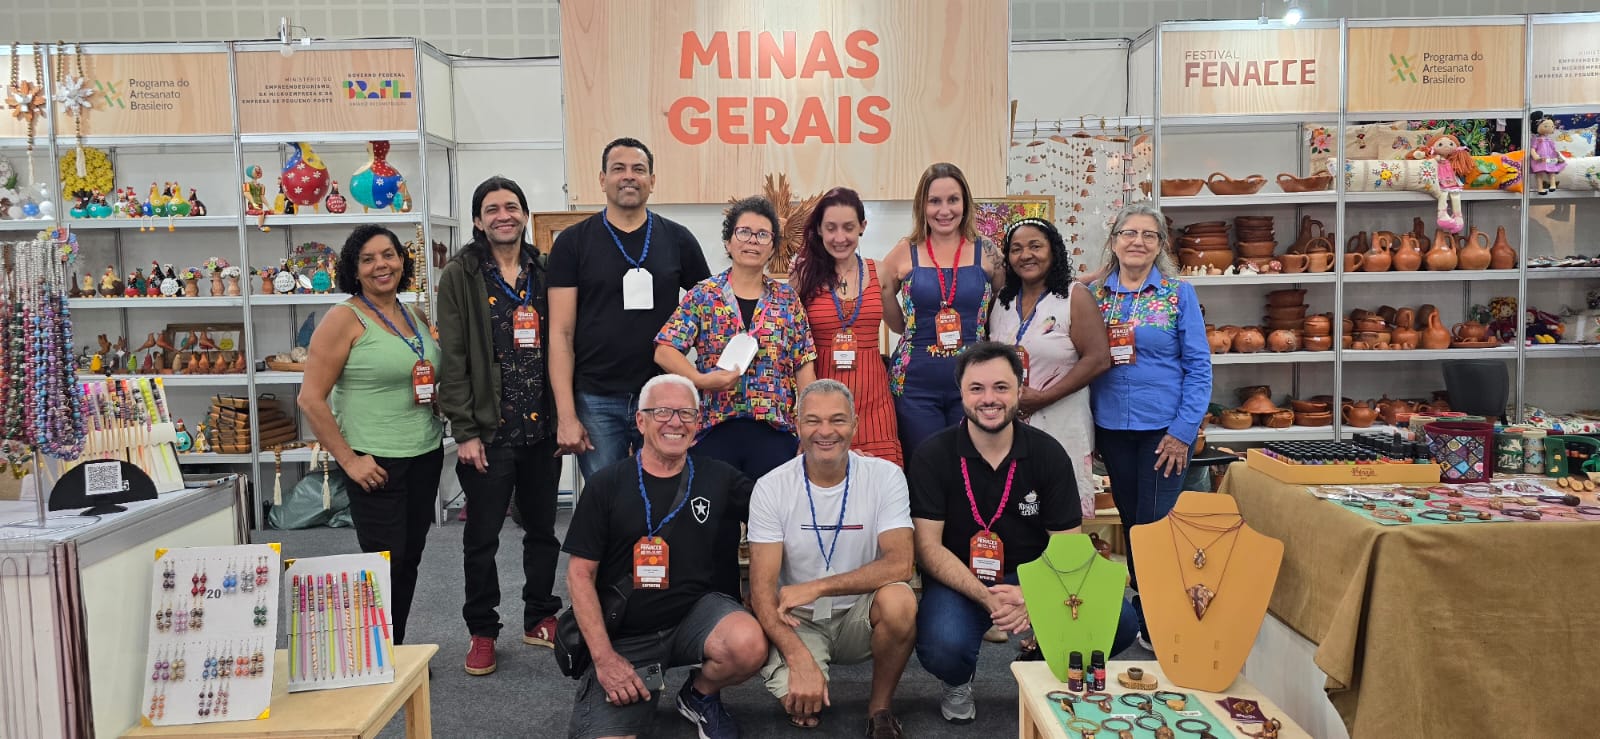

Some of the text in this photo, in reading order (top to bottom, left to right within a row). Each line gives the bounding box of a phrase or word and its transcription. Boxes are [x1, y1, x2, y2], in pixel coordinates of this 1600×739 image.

[680, 29, 880, 79] MINAS
[1185, 50, 1240, 60] FESTIVAL
[1423, 51, 1484, 64] Programa do
[1184, 59, 1316, 87] FENACCE
[1422, 64, 1474, 73] Artesanato
[128, 77, 190, 90] Programa do
[1422, 75, 1466, 84] Brasileiro
[129, 90, 181, 99] Artesanato
[342, 80, 412, 99] BRASIL
[130, 101, 174, 111] Brasileiro
[667, 95, 892, 145] GERAIS
[206, 589, 222, 600] 20
